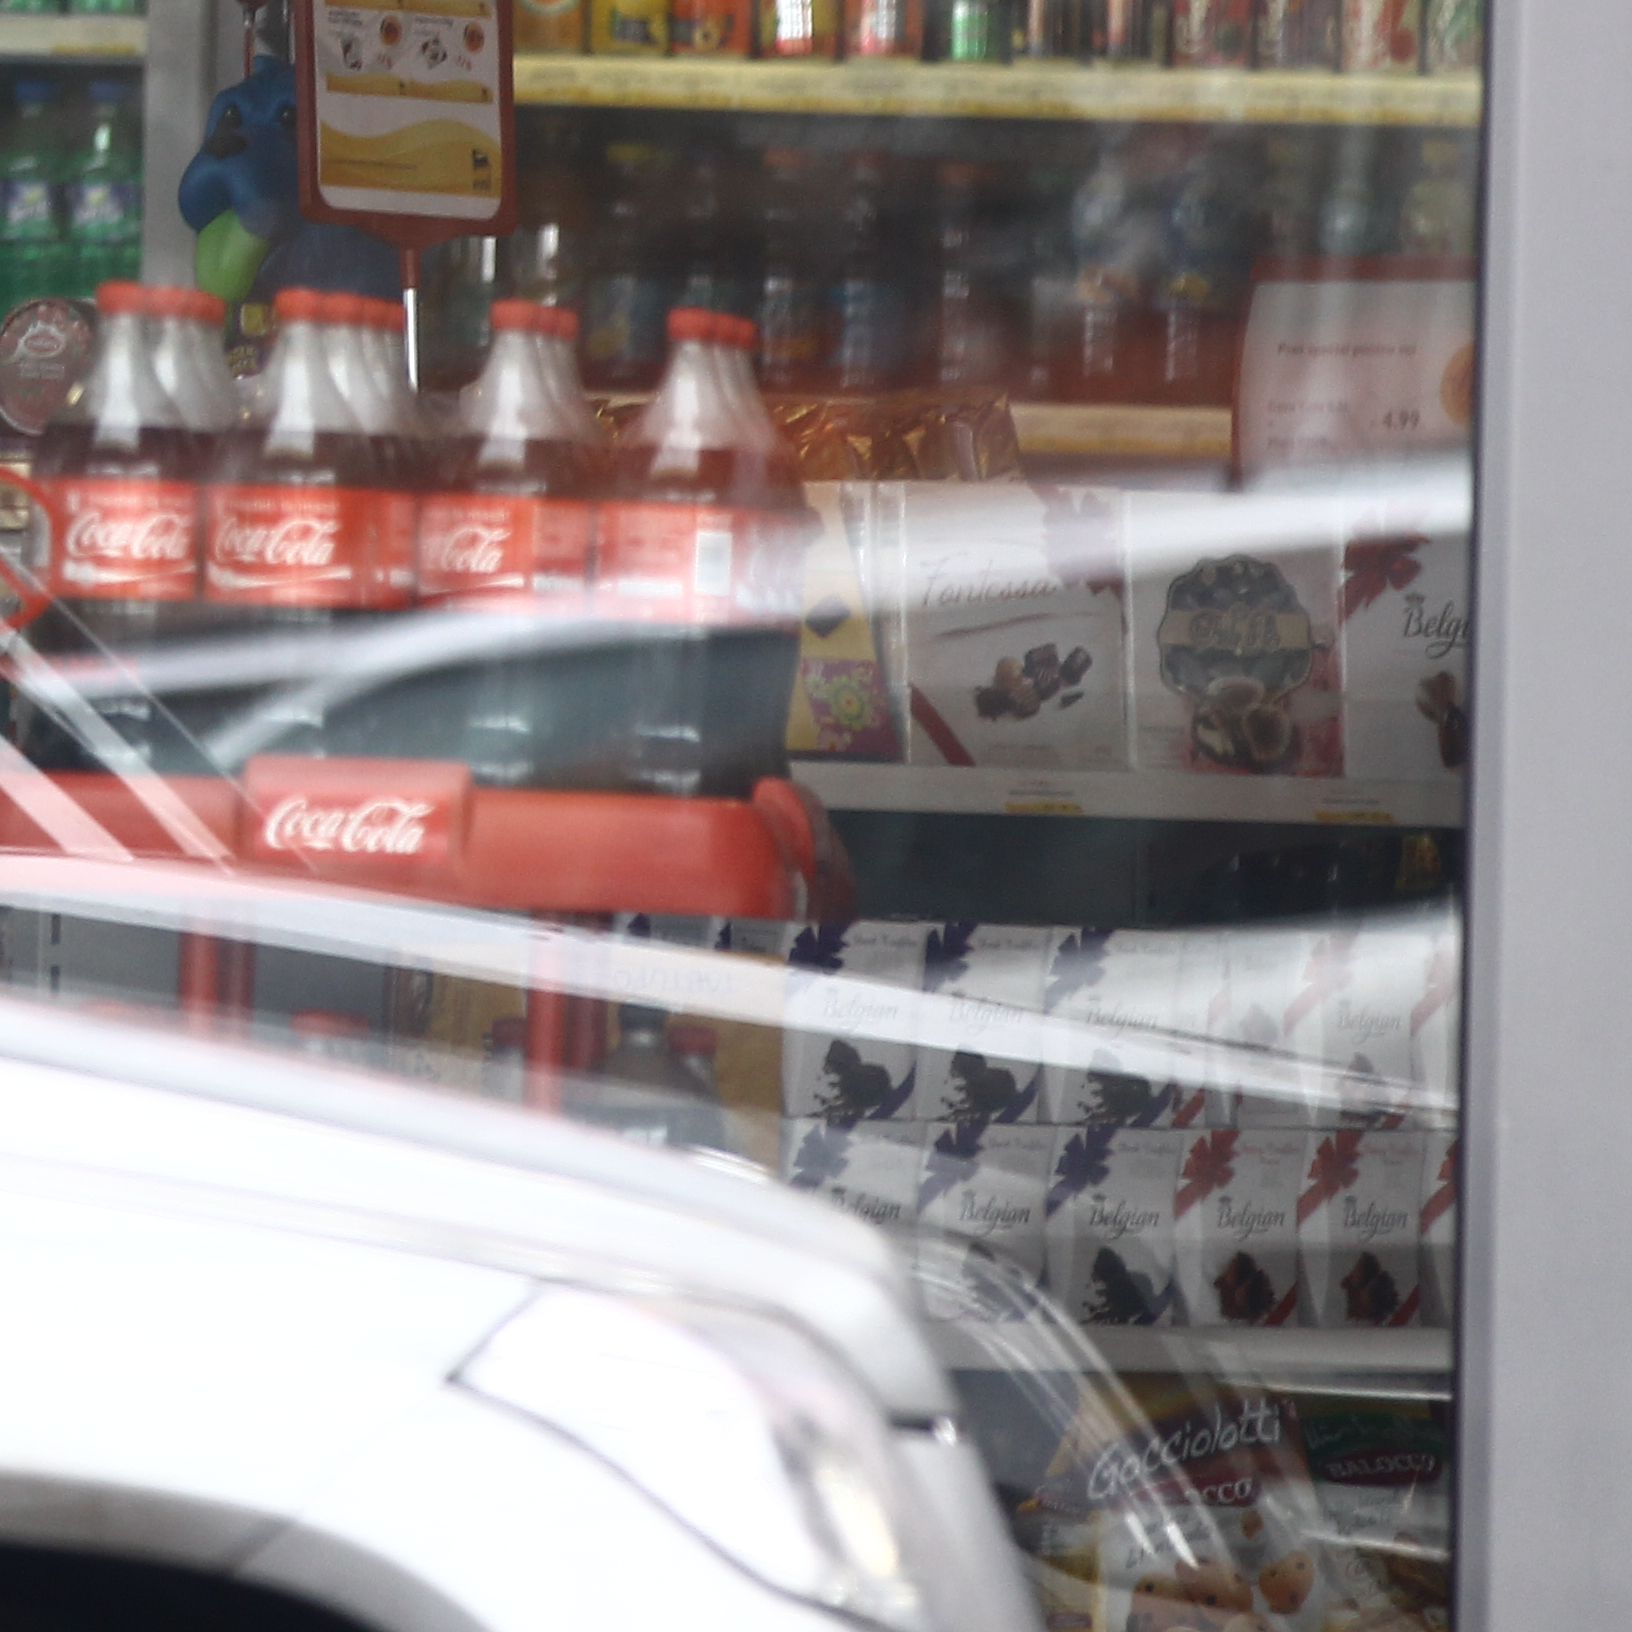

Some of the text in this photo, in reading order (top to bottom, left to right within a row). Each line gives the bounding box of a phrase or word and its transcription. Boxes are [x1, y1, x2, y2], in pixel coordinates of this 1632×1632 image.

[960, 1197, 1031, 1235] Belgian
[1089, 1197, 1161, 1239] Belgian
[1217, 1200, 1285, 1242] Belgian
[1344, 1201, 1409, 1244] Belgian
